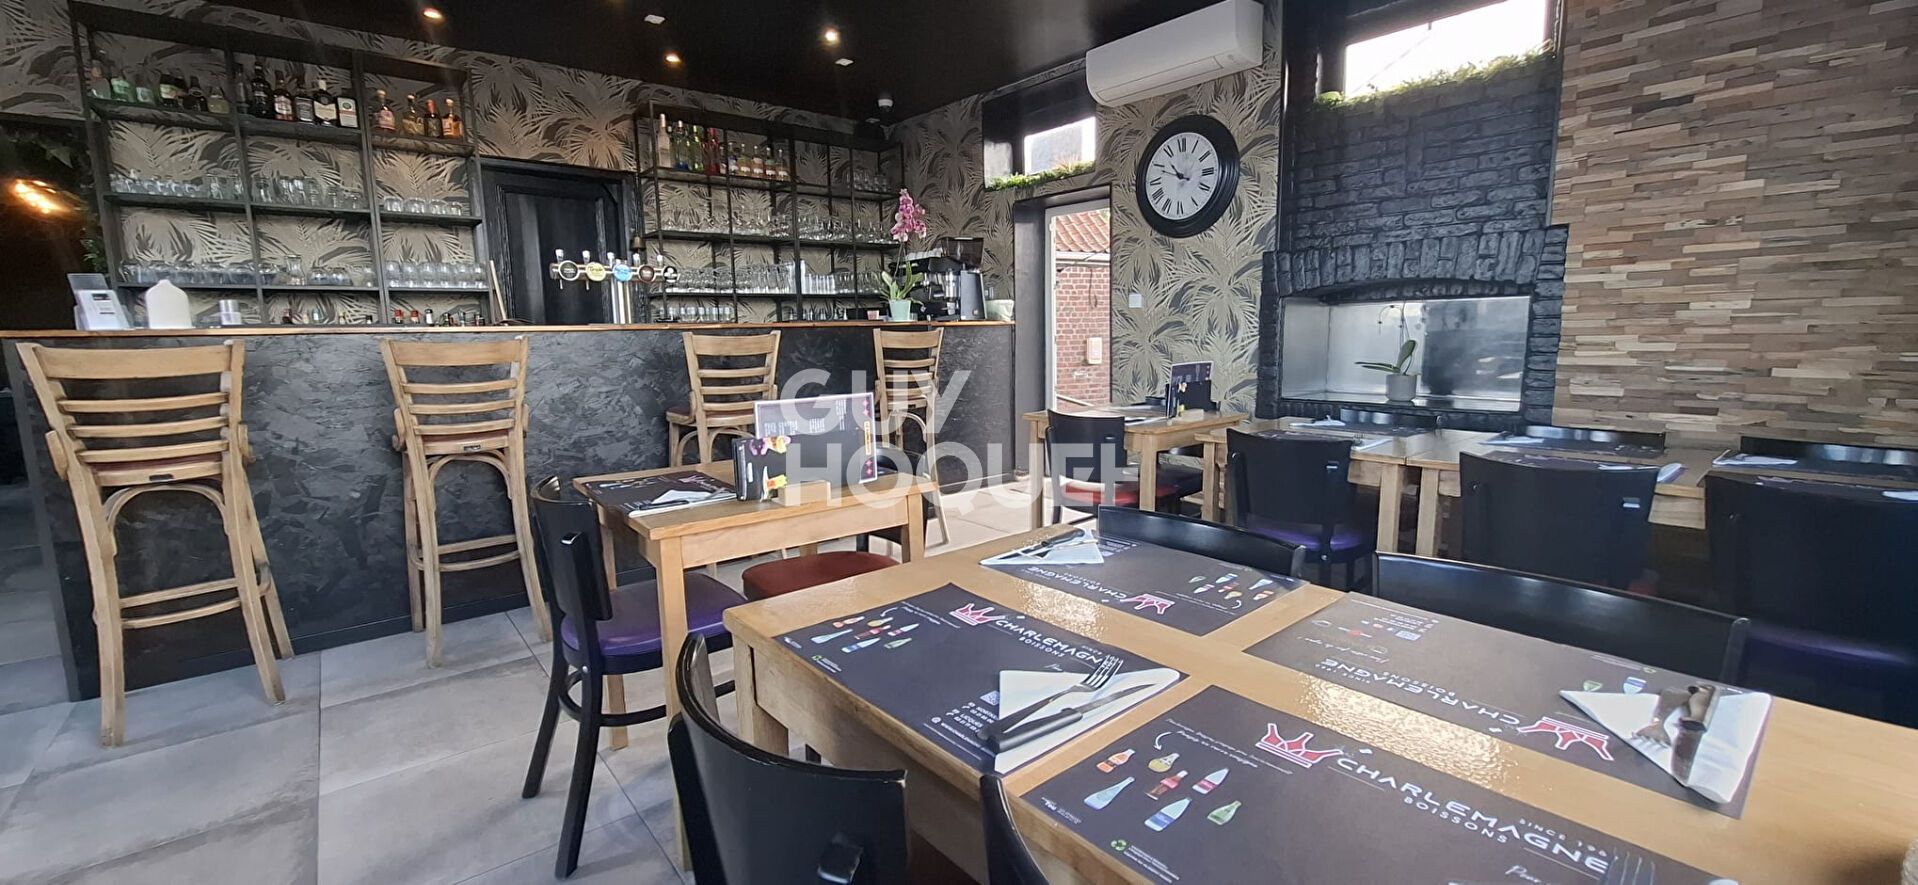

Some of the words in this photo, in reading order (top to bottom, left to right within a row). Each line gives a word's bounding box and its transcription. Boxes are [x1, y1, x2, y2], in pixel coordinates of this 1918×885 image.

[1019, 636, 1066, 657] BOISSONS
[1321, 657, 1521, 725] CHARLEMAGNE
[1336, 758, 1610, 875] CHARLEMAGNE
[1403, 797, 1508, 844] BOISSONS
[1518, 818, 1567, 841] SINCE
